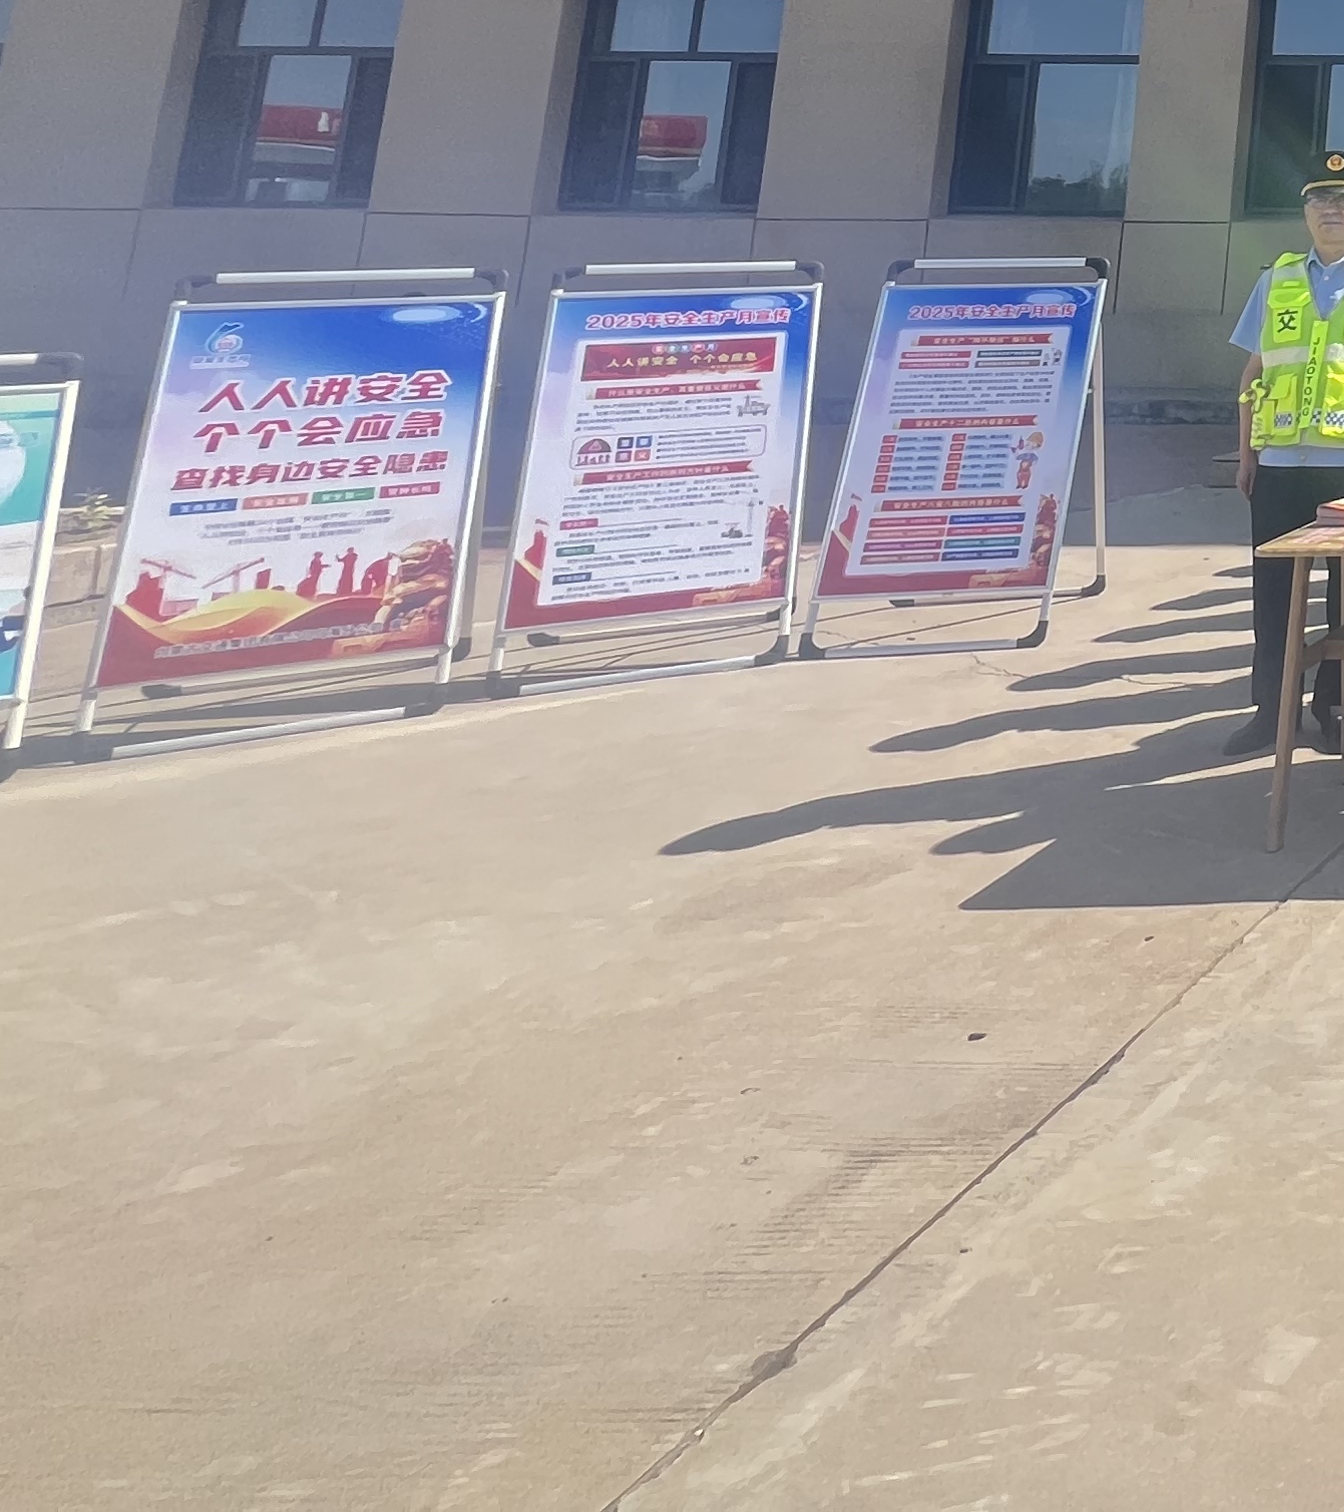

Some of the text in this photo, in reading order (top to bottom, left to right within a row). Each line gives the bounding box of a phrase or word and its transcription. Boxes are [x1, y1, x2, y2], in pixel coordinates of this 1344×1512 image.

[585, 307, 791, 330] 2025年安全生产月宣传
[908, 303, 1077, 321] 2025年安全生产月宣传
[1277, 309, 1299, 333] 交
[198, 371, 450, 413] 人人讲安全
[1302, 337, 1321, 416] JIAOTONG
[193, 410, 443, 453] 个个会应急
[170, 450, 449, 491] 查找身边安全隐患
